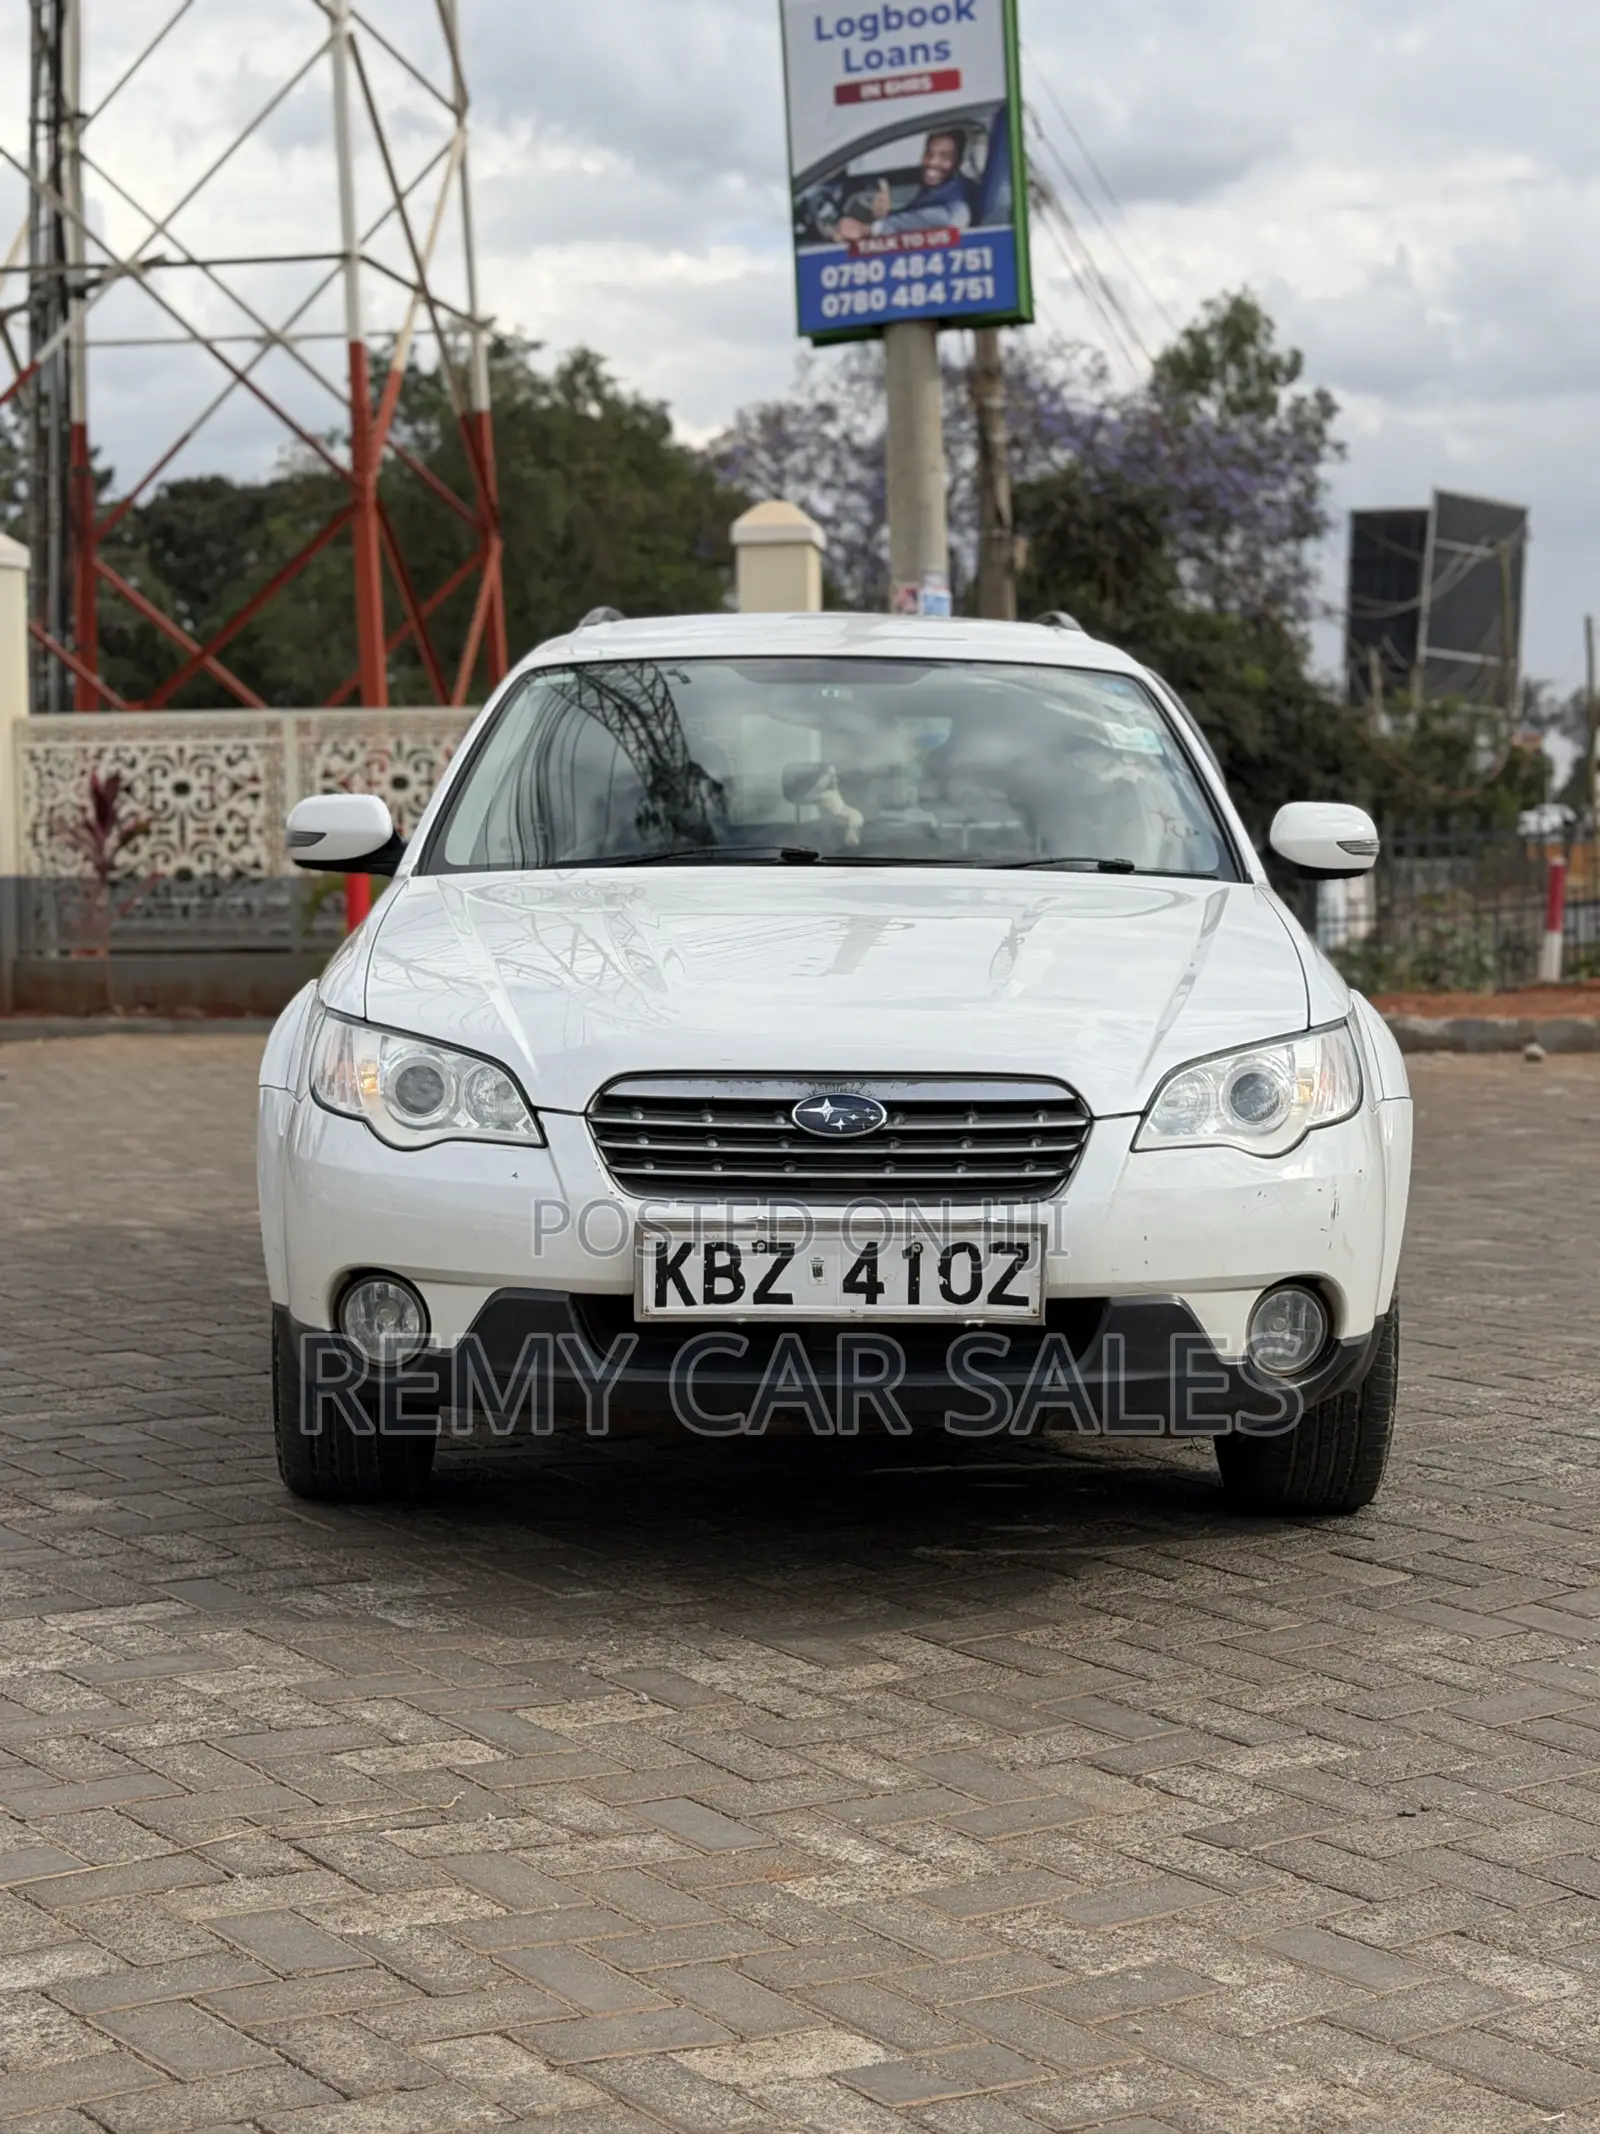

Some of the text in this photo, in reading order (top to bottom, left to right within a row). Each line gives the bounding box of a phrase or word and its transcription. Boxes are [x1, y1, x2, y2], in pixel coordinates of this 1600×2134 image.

[813, 0, 977, 42] Logbook
[842, 39, 952, 74] Loans
[857, 229, 951, 254] TALK TO US
[890, 252, 945, 280] 484
[948, 246, 993, 274] 751
[890, 281, 947, 309] 484
[949, 274, 996, 303] 751
[653, 1240, 1031, 1309] KBZ 410Z
